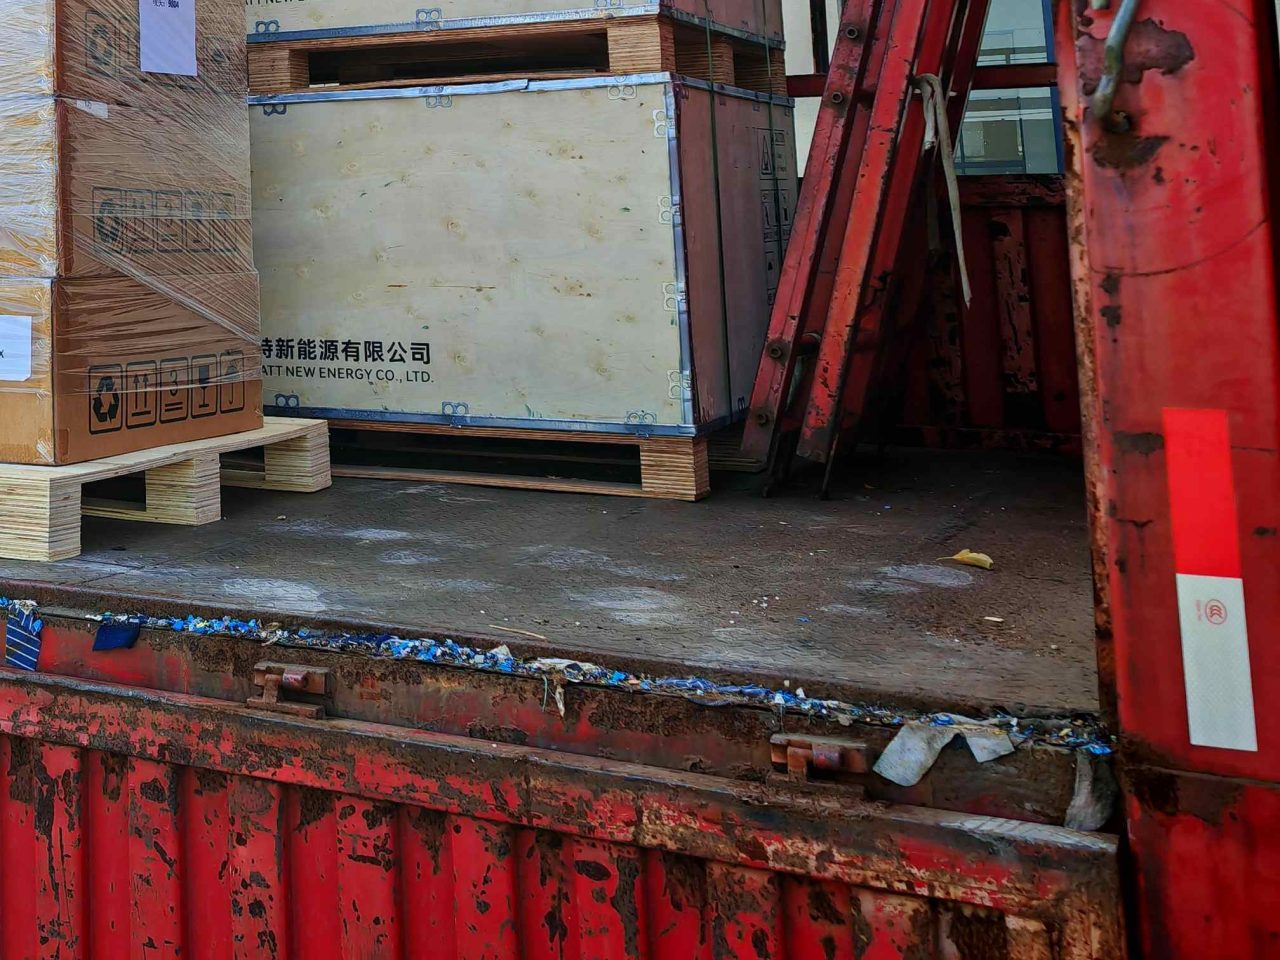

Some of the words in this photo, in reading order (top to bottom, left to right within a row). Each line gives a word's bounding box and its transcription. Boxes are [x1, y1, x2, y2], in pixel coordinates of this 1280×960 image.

[286, 366, 316, 378] NEW
[320, 368, 373, 380] ENERGY
[376, 370, 403, 383] CO.,
[406, 371, 435, 383] LTD.
